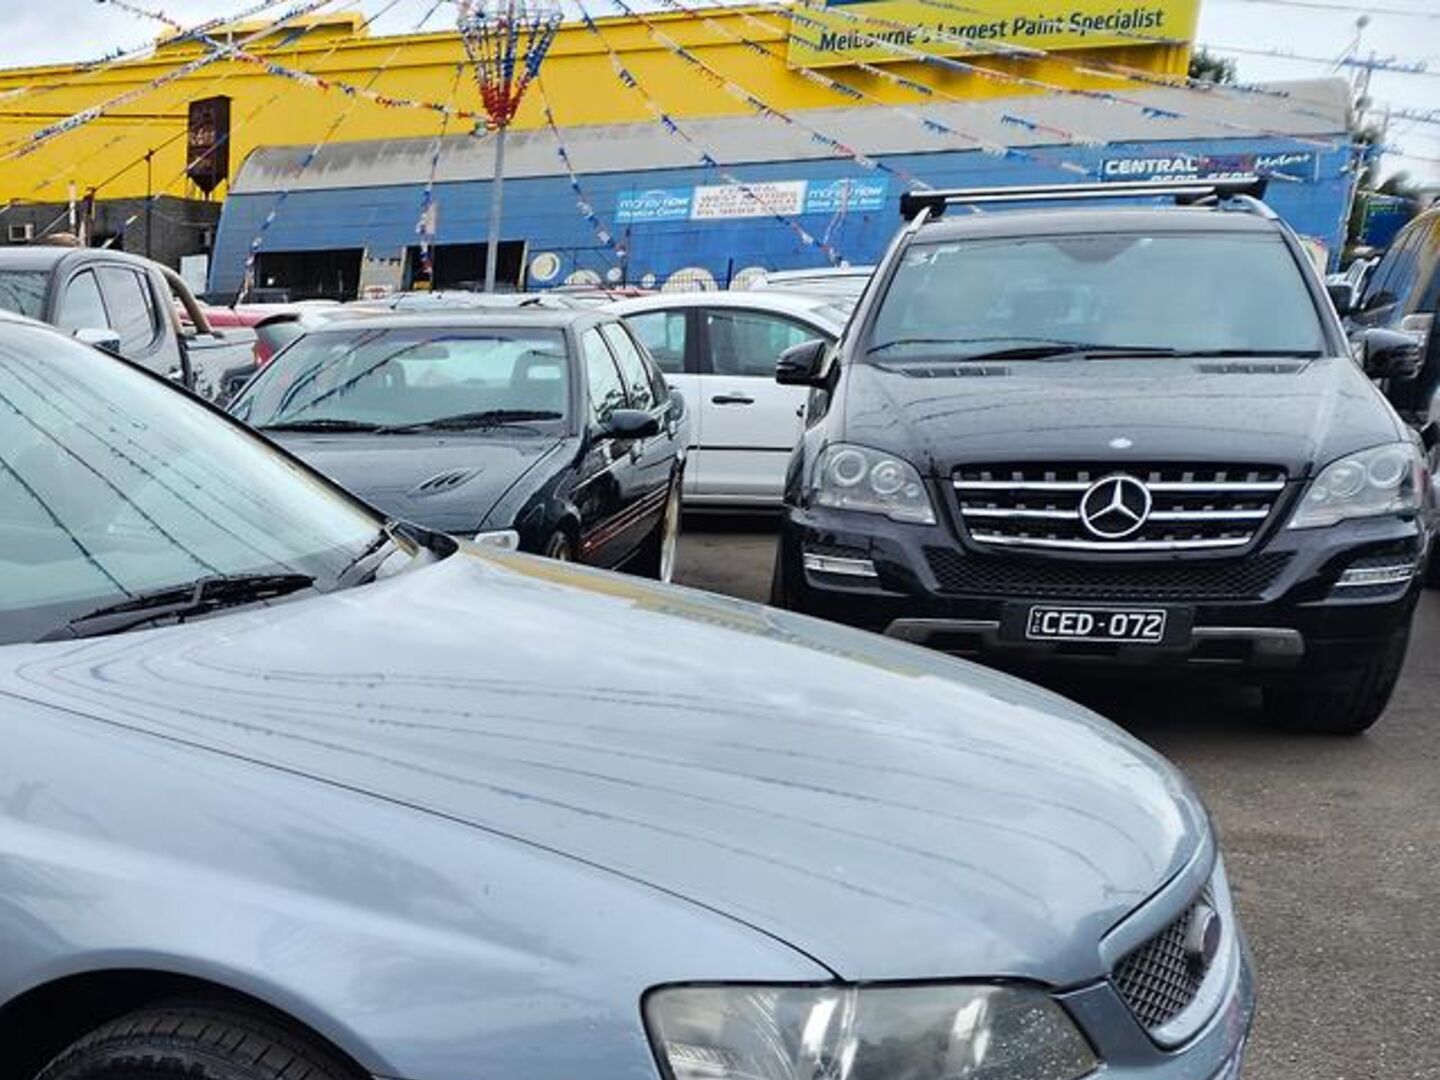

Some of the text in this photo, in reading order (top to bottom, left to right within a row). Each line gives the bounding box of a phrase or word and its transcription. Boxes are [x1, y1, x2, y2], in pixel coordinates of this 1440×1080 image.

[819, 21, 930, 51] Melbourne's
[1012, 14, 1064, 36] Paint
[1068, 6, 1164, 37] Specialist
[1105, 157, 1198, 174] CENTRAL
